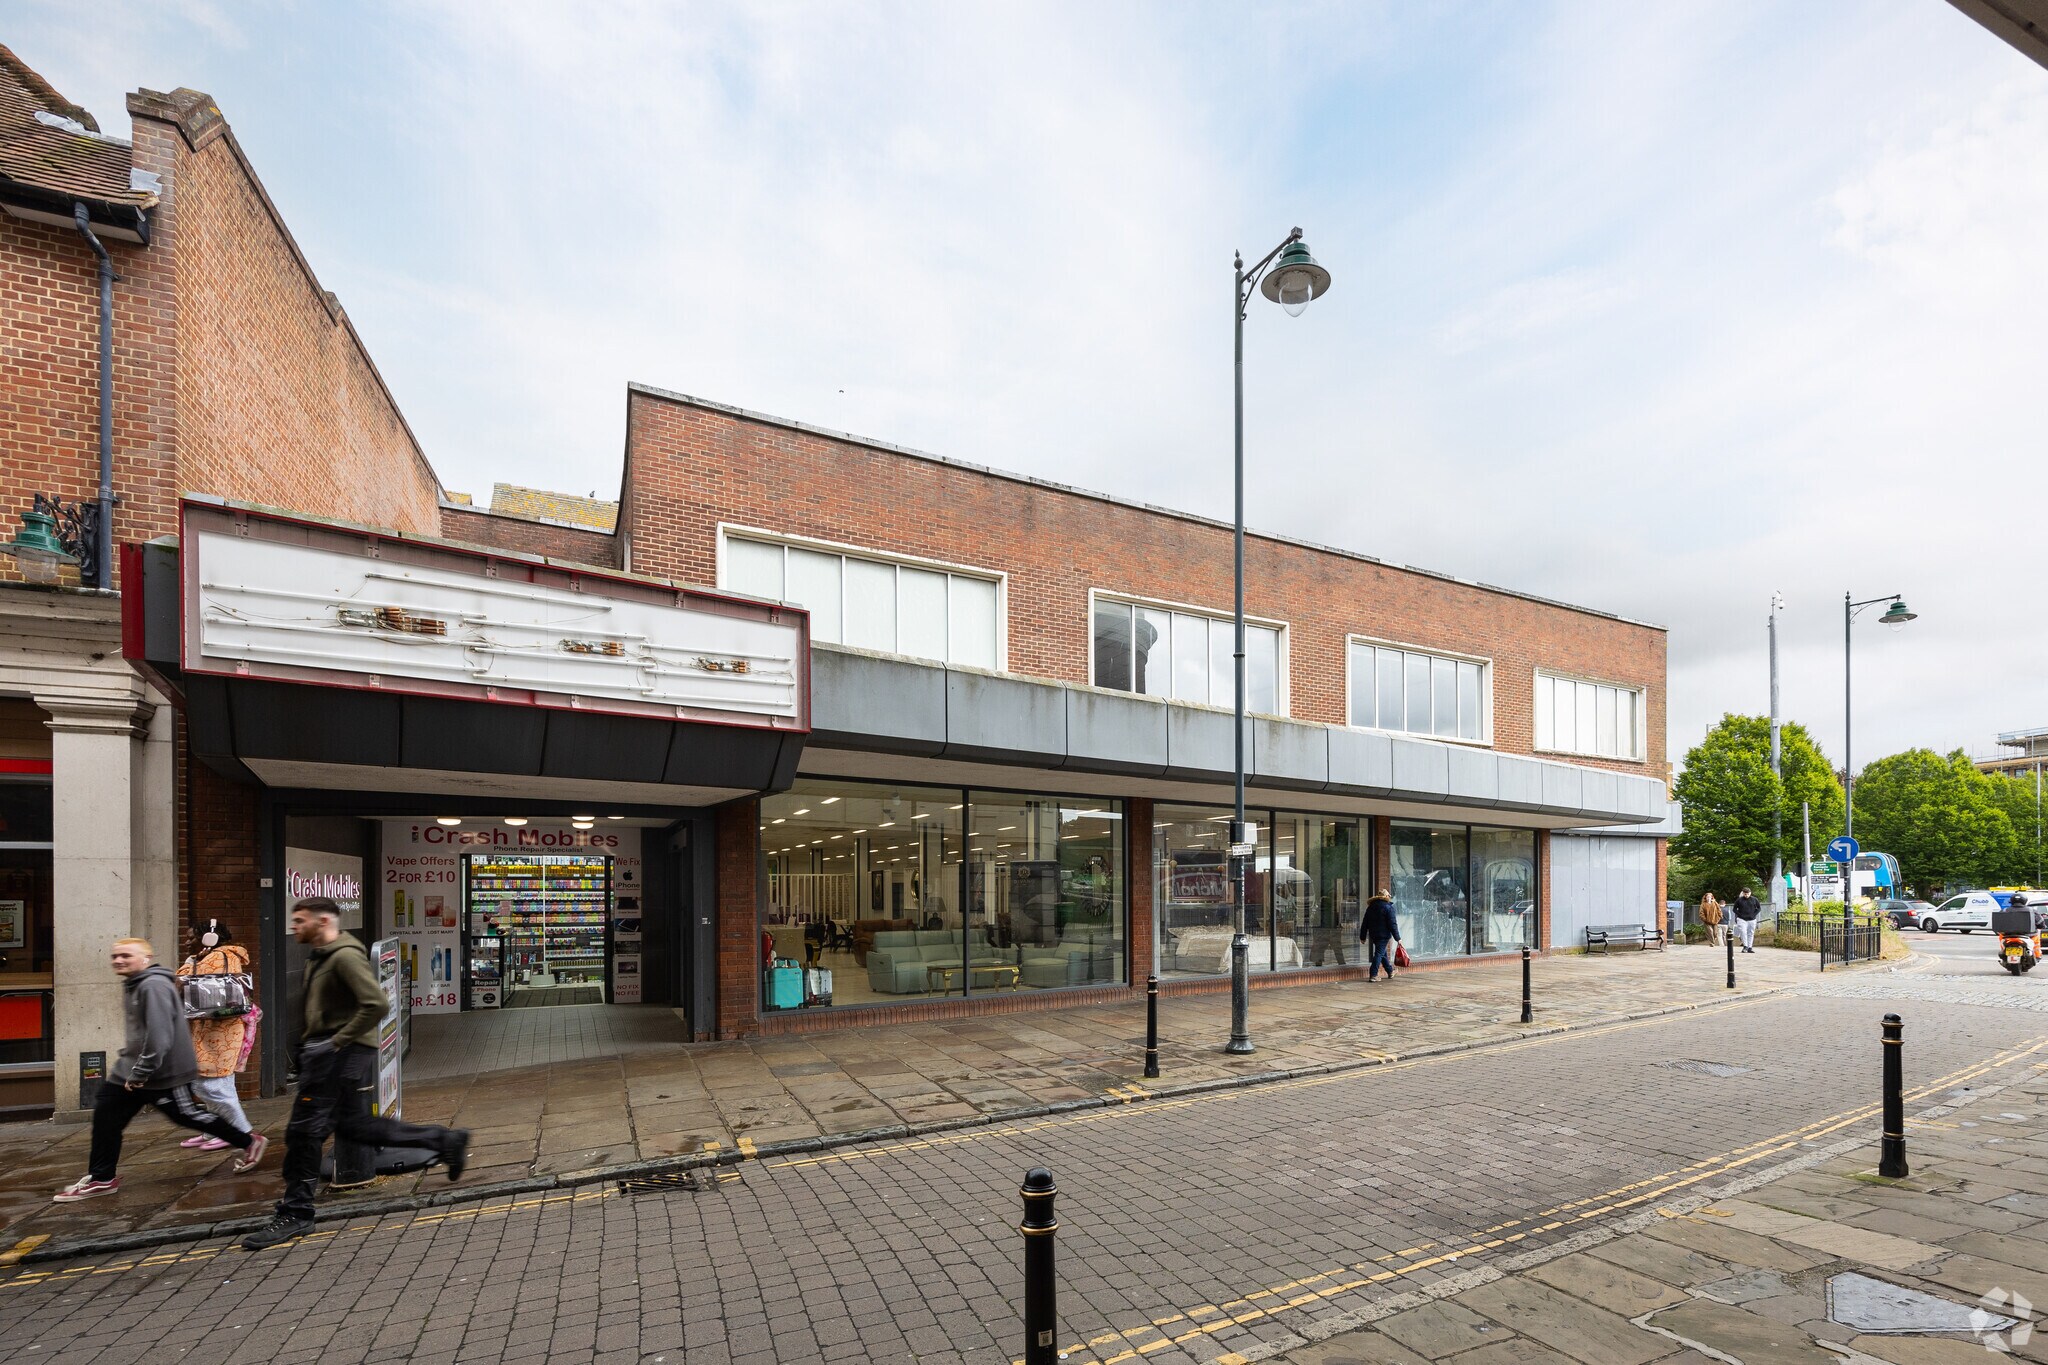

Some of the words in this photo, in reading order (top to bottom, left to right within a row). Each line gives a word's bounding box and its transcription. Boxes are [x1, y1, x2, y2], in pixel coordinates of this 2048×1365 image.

[518, 829, 619, 847] Mobiles
[386, 856, 417, 867] Vape
[420, 856, 455, 865] Offers
[615, 858, 628, 866] We
[629, 857, 641, 866] Fix
[424, 870, 456, 883] £10
[324, 874, 361, 899] Mobiles
[426, 993, 457, 1006] £18
